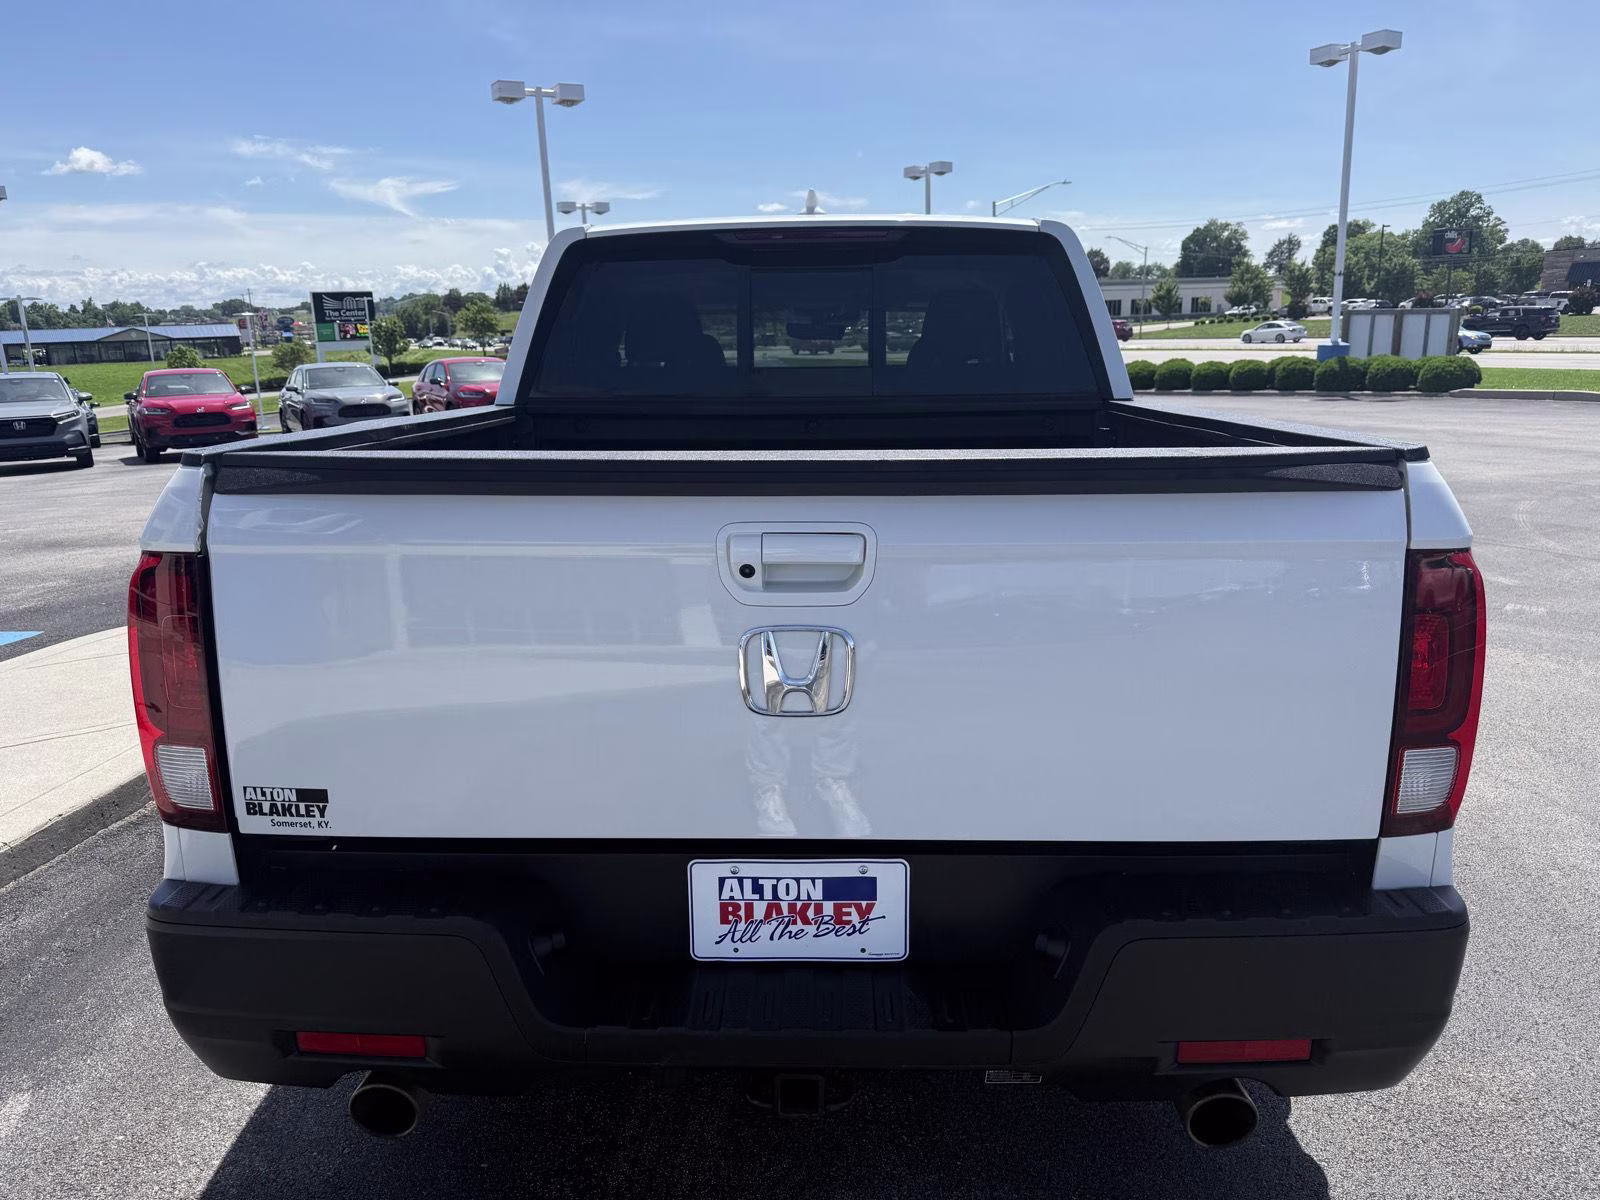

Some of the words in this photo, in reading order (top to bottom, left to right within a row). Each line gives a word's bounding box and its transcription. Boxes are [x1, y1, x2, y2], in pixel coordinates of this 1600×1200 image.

[245, 787, 297, 802] ALTON
[245, 802, 328, 818] BLAKLEY
[271, 819, 315, 829] Somerset,
[317, 820, 332, 829] KY.
[720, 878, 823, 901] ALTON
[719, 902, 876, 926] BLAKLEY
[715, 918, 763, 945] All
[766, 915, 808, 941] The
[811, 914, 886, 938] Best
